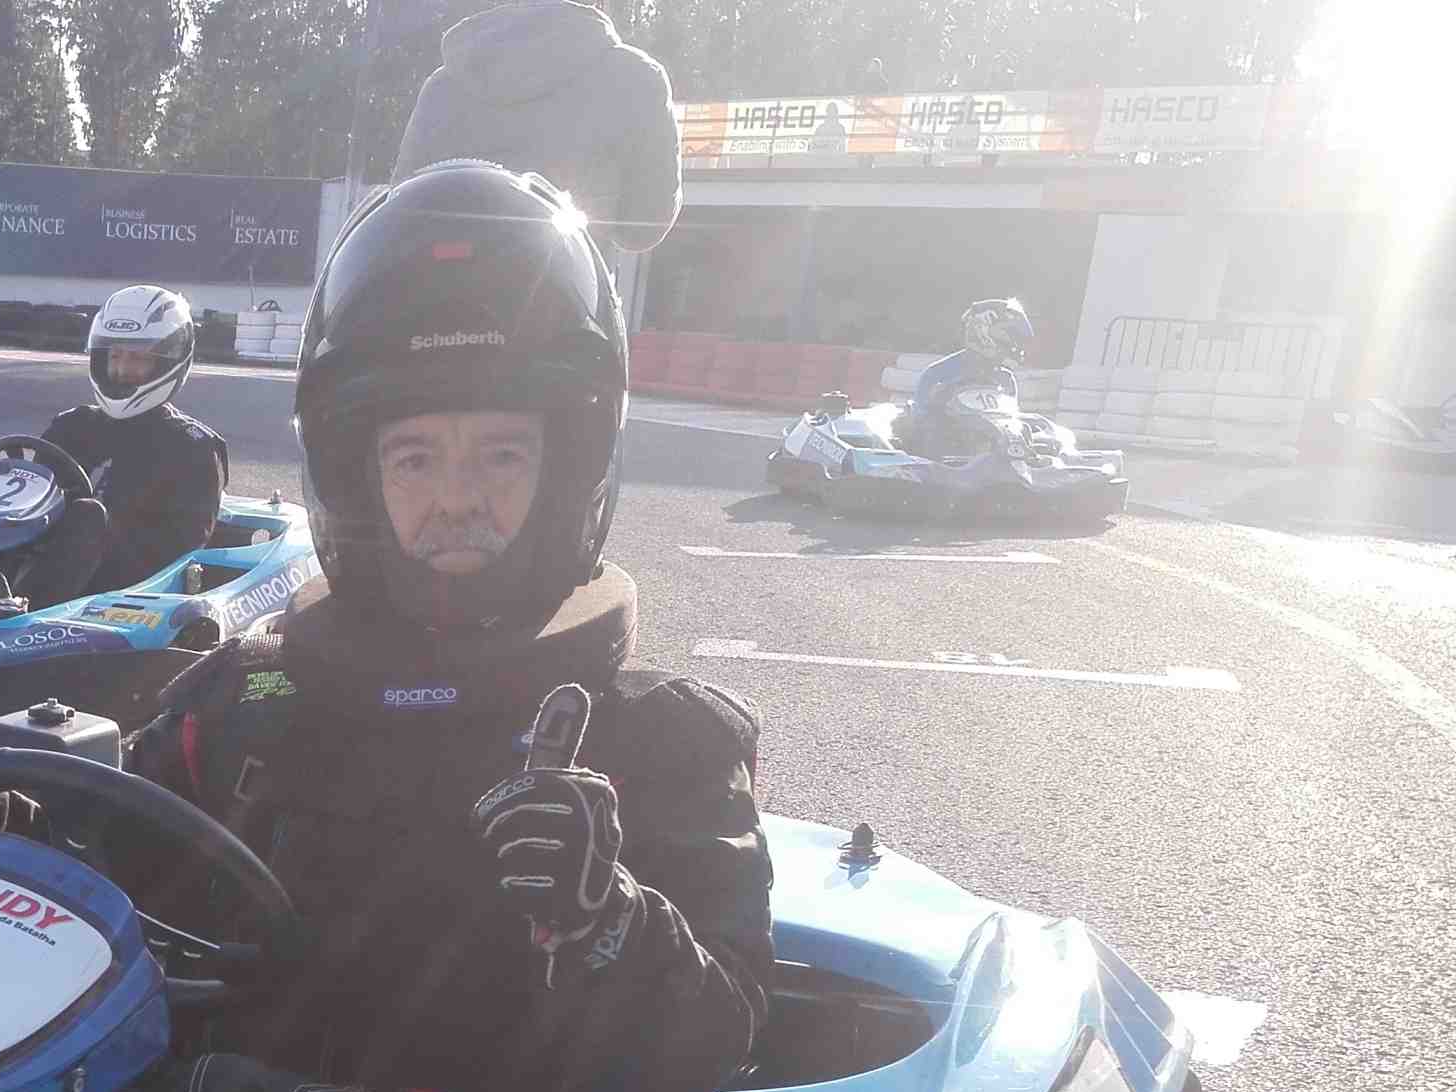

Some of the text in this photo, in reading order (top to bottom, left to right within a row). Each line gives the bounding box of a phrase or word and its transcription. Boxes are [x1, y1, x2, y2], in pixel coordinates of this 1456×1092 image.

[734, 106, 815, 129] HASCO
[1109, 95, 1217, 122] HASCO
[235, 214, 256, 226] REAL
[106, 221, 197, 243] LOGISTICS
[235, 227, 299, 246] ESTATE
[108, 321, 136, 332] HJC
[410, 329, 505, 351] Schuberth
[221, 567, 305, 628] TECNIROLO
[384, 687, 457, 708] sparco
[13, 921, 56, 946] Batalha
